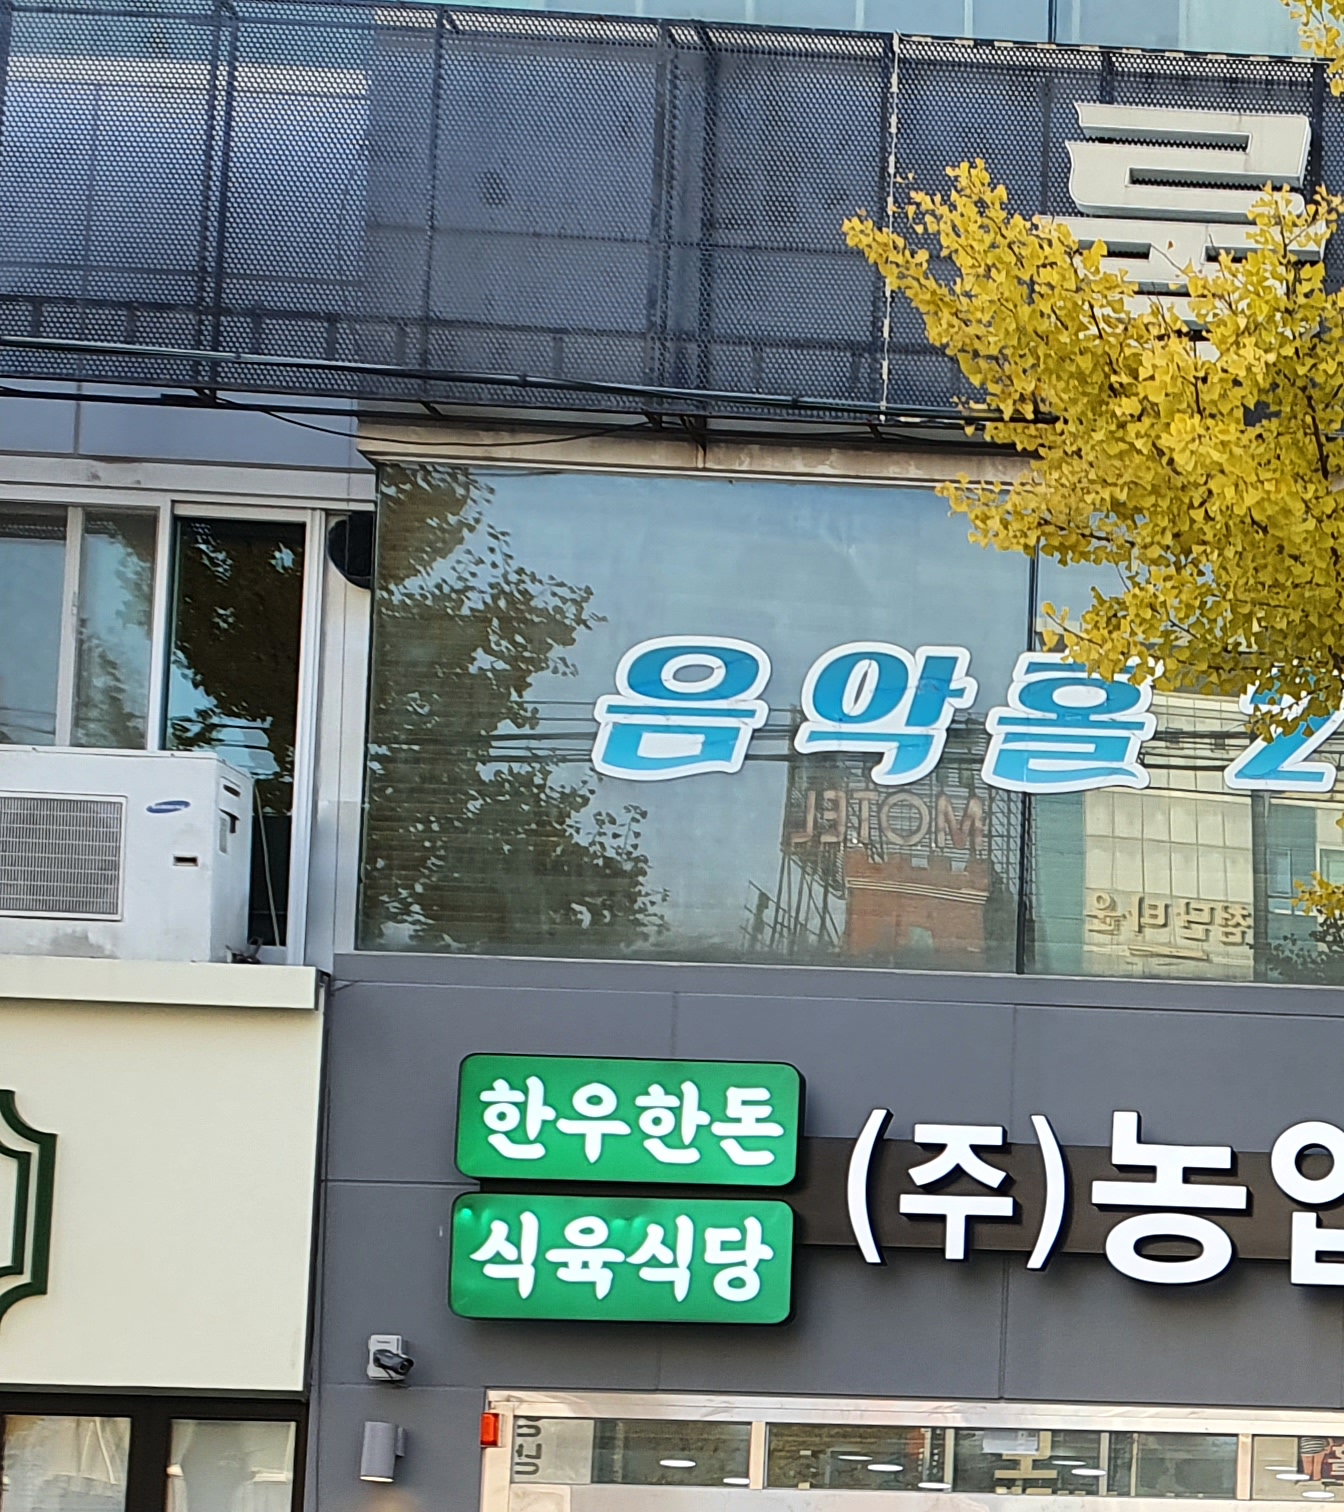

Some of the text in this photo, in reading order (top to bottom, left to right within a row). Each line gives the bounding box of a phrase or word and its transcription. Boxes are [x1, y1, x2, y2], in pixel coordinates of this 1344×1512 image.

[592, 634, 1157, 793] 음악홀
[479, 1075, 785, 1168] 한우한돈
[470, 1211, 775, 1303] 식육식당
